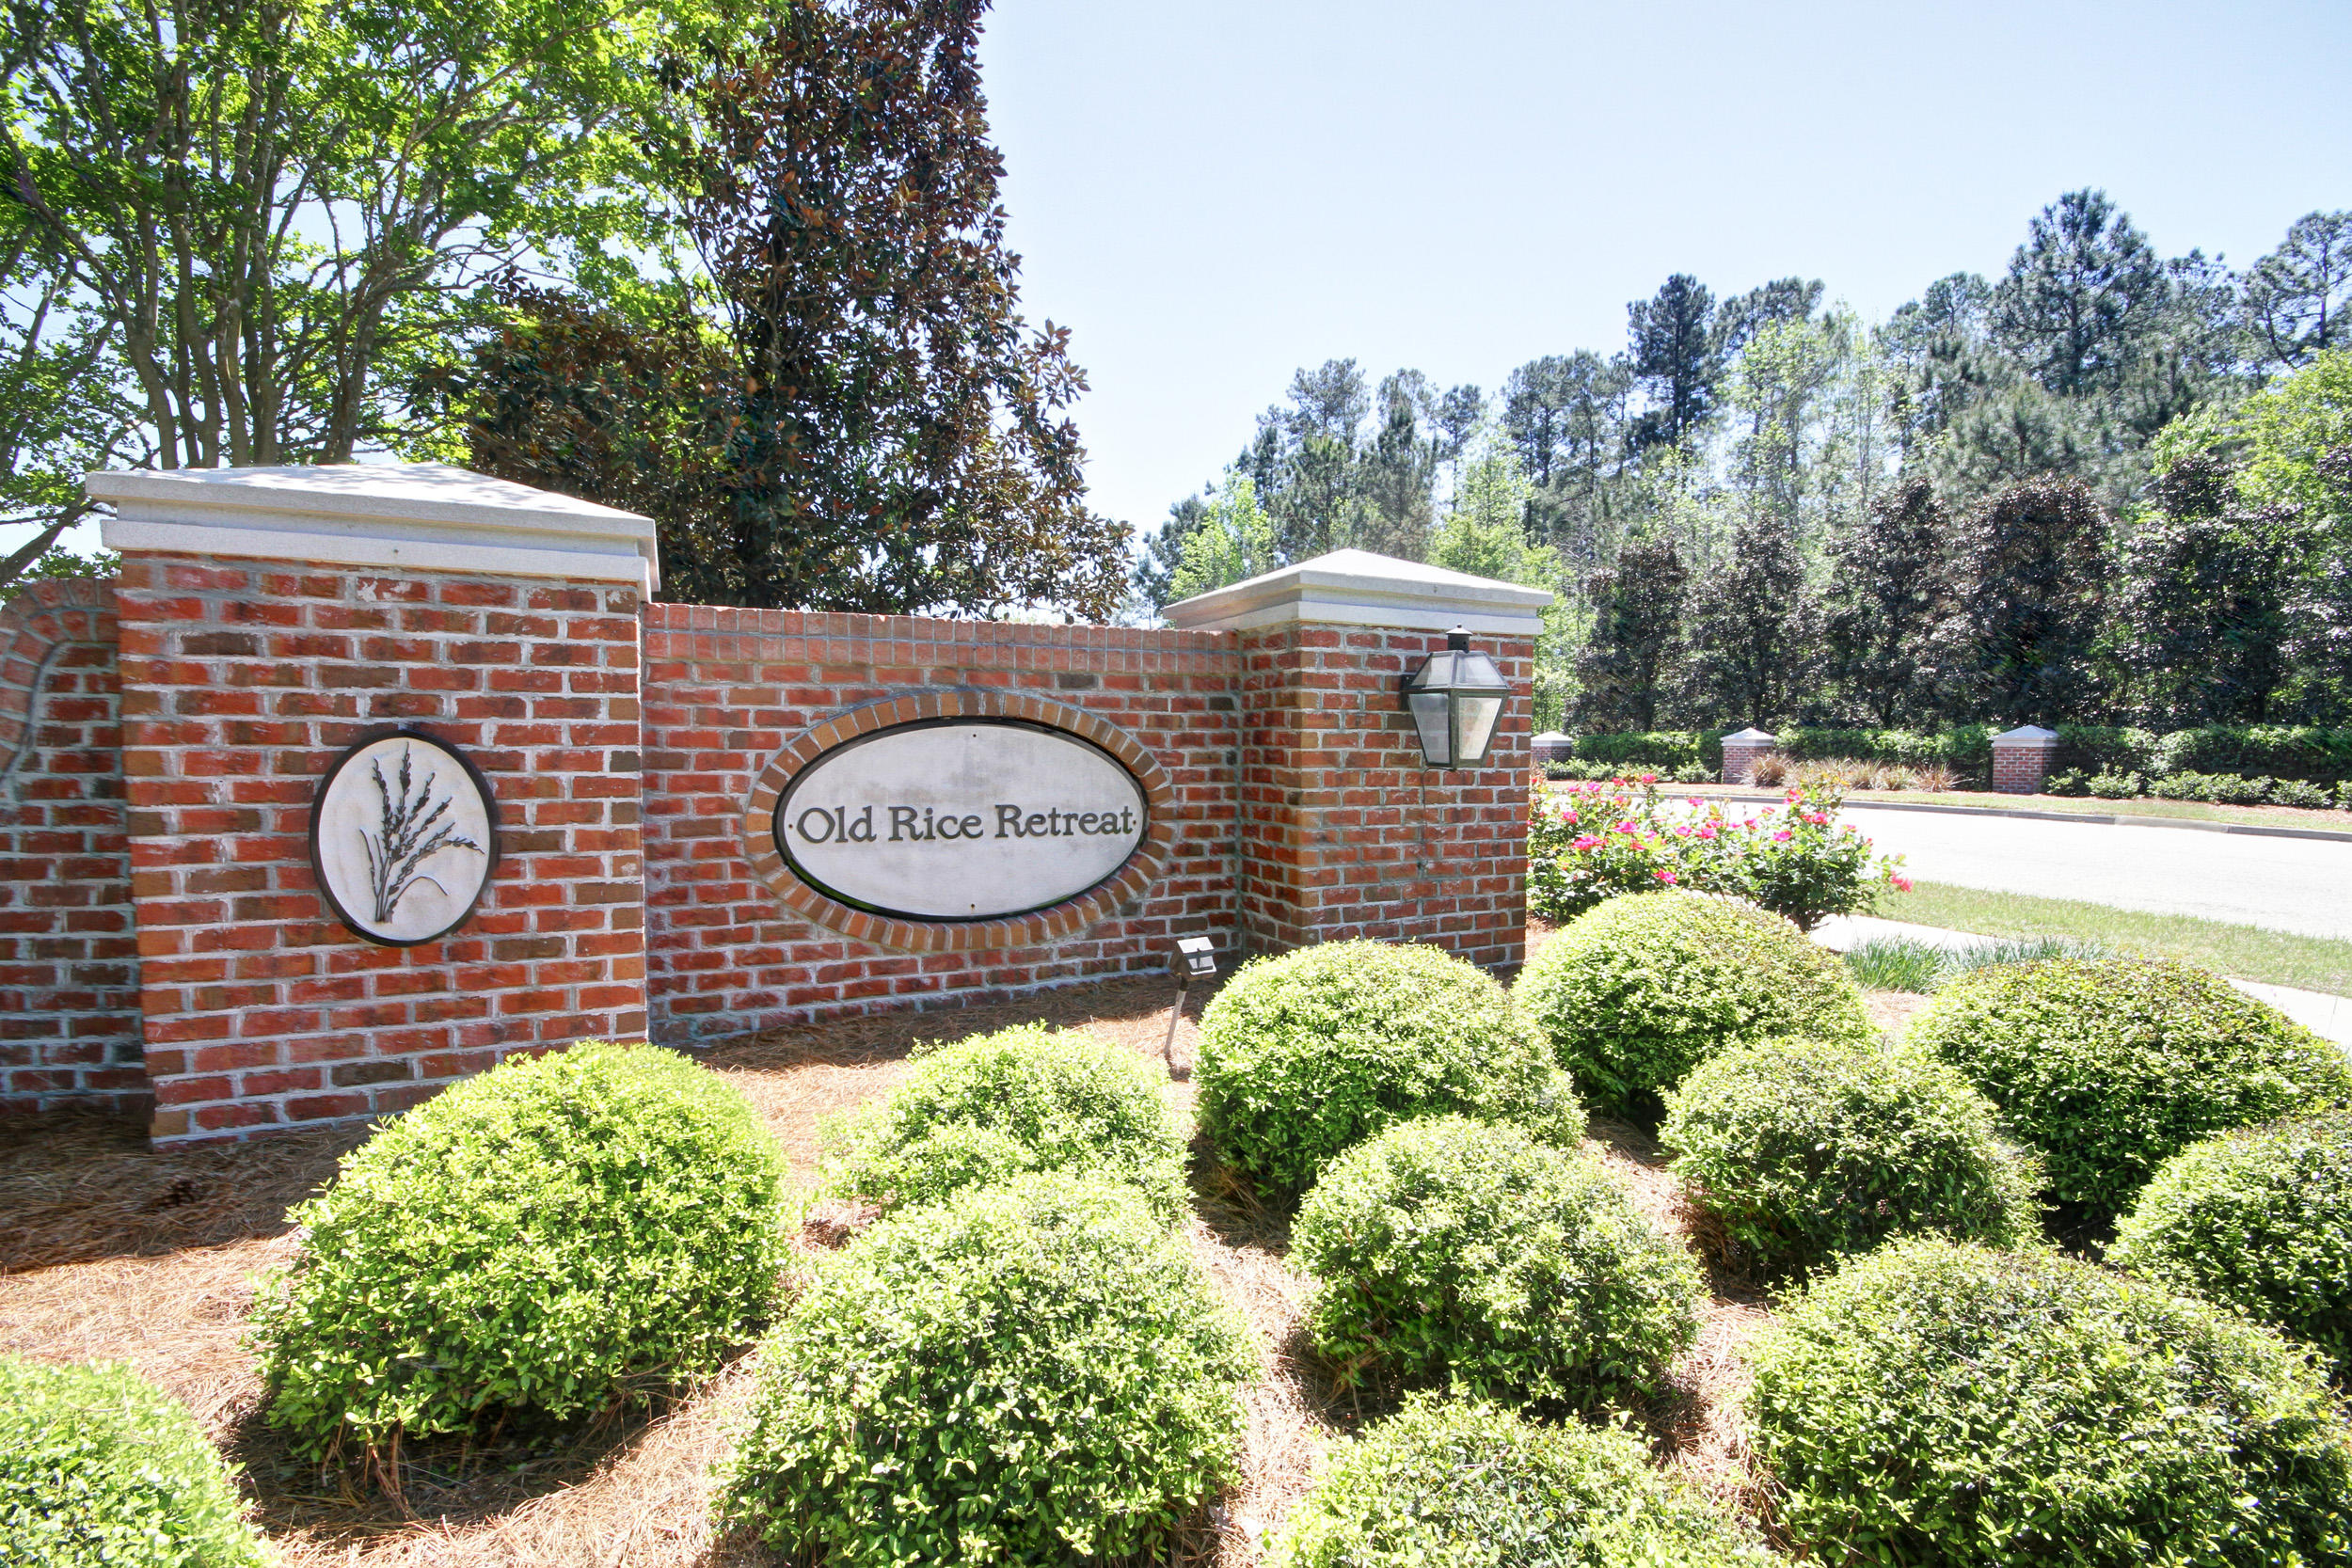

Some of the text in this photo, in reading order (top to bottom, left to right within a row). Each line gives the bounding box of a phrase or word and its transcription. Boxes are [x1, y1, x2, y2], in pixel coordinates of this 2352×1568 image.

[796, 804, 1133, 844] Old Rice Retreat
